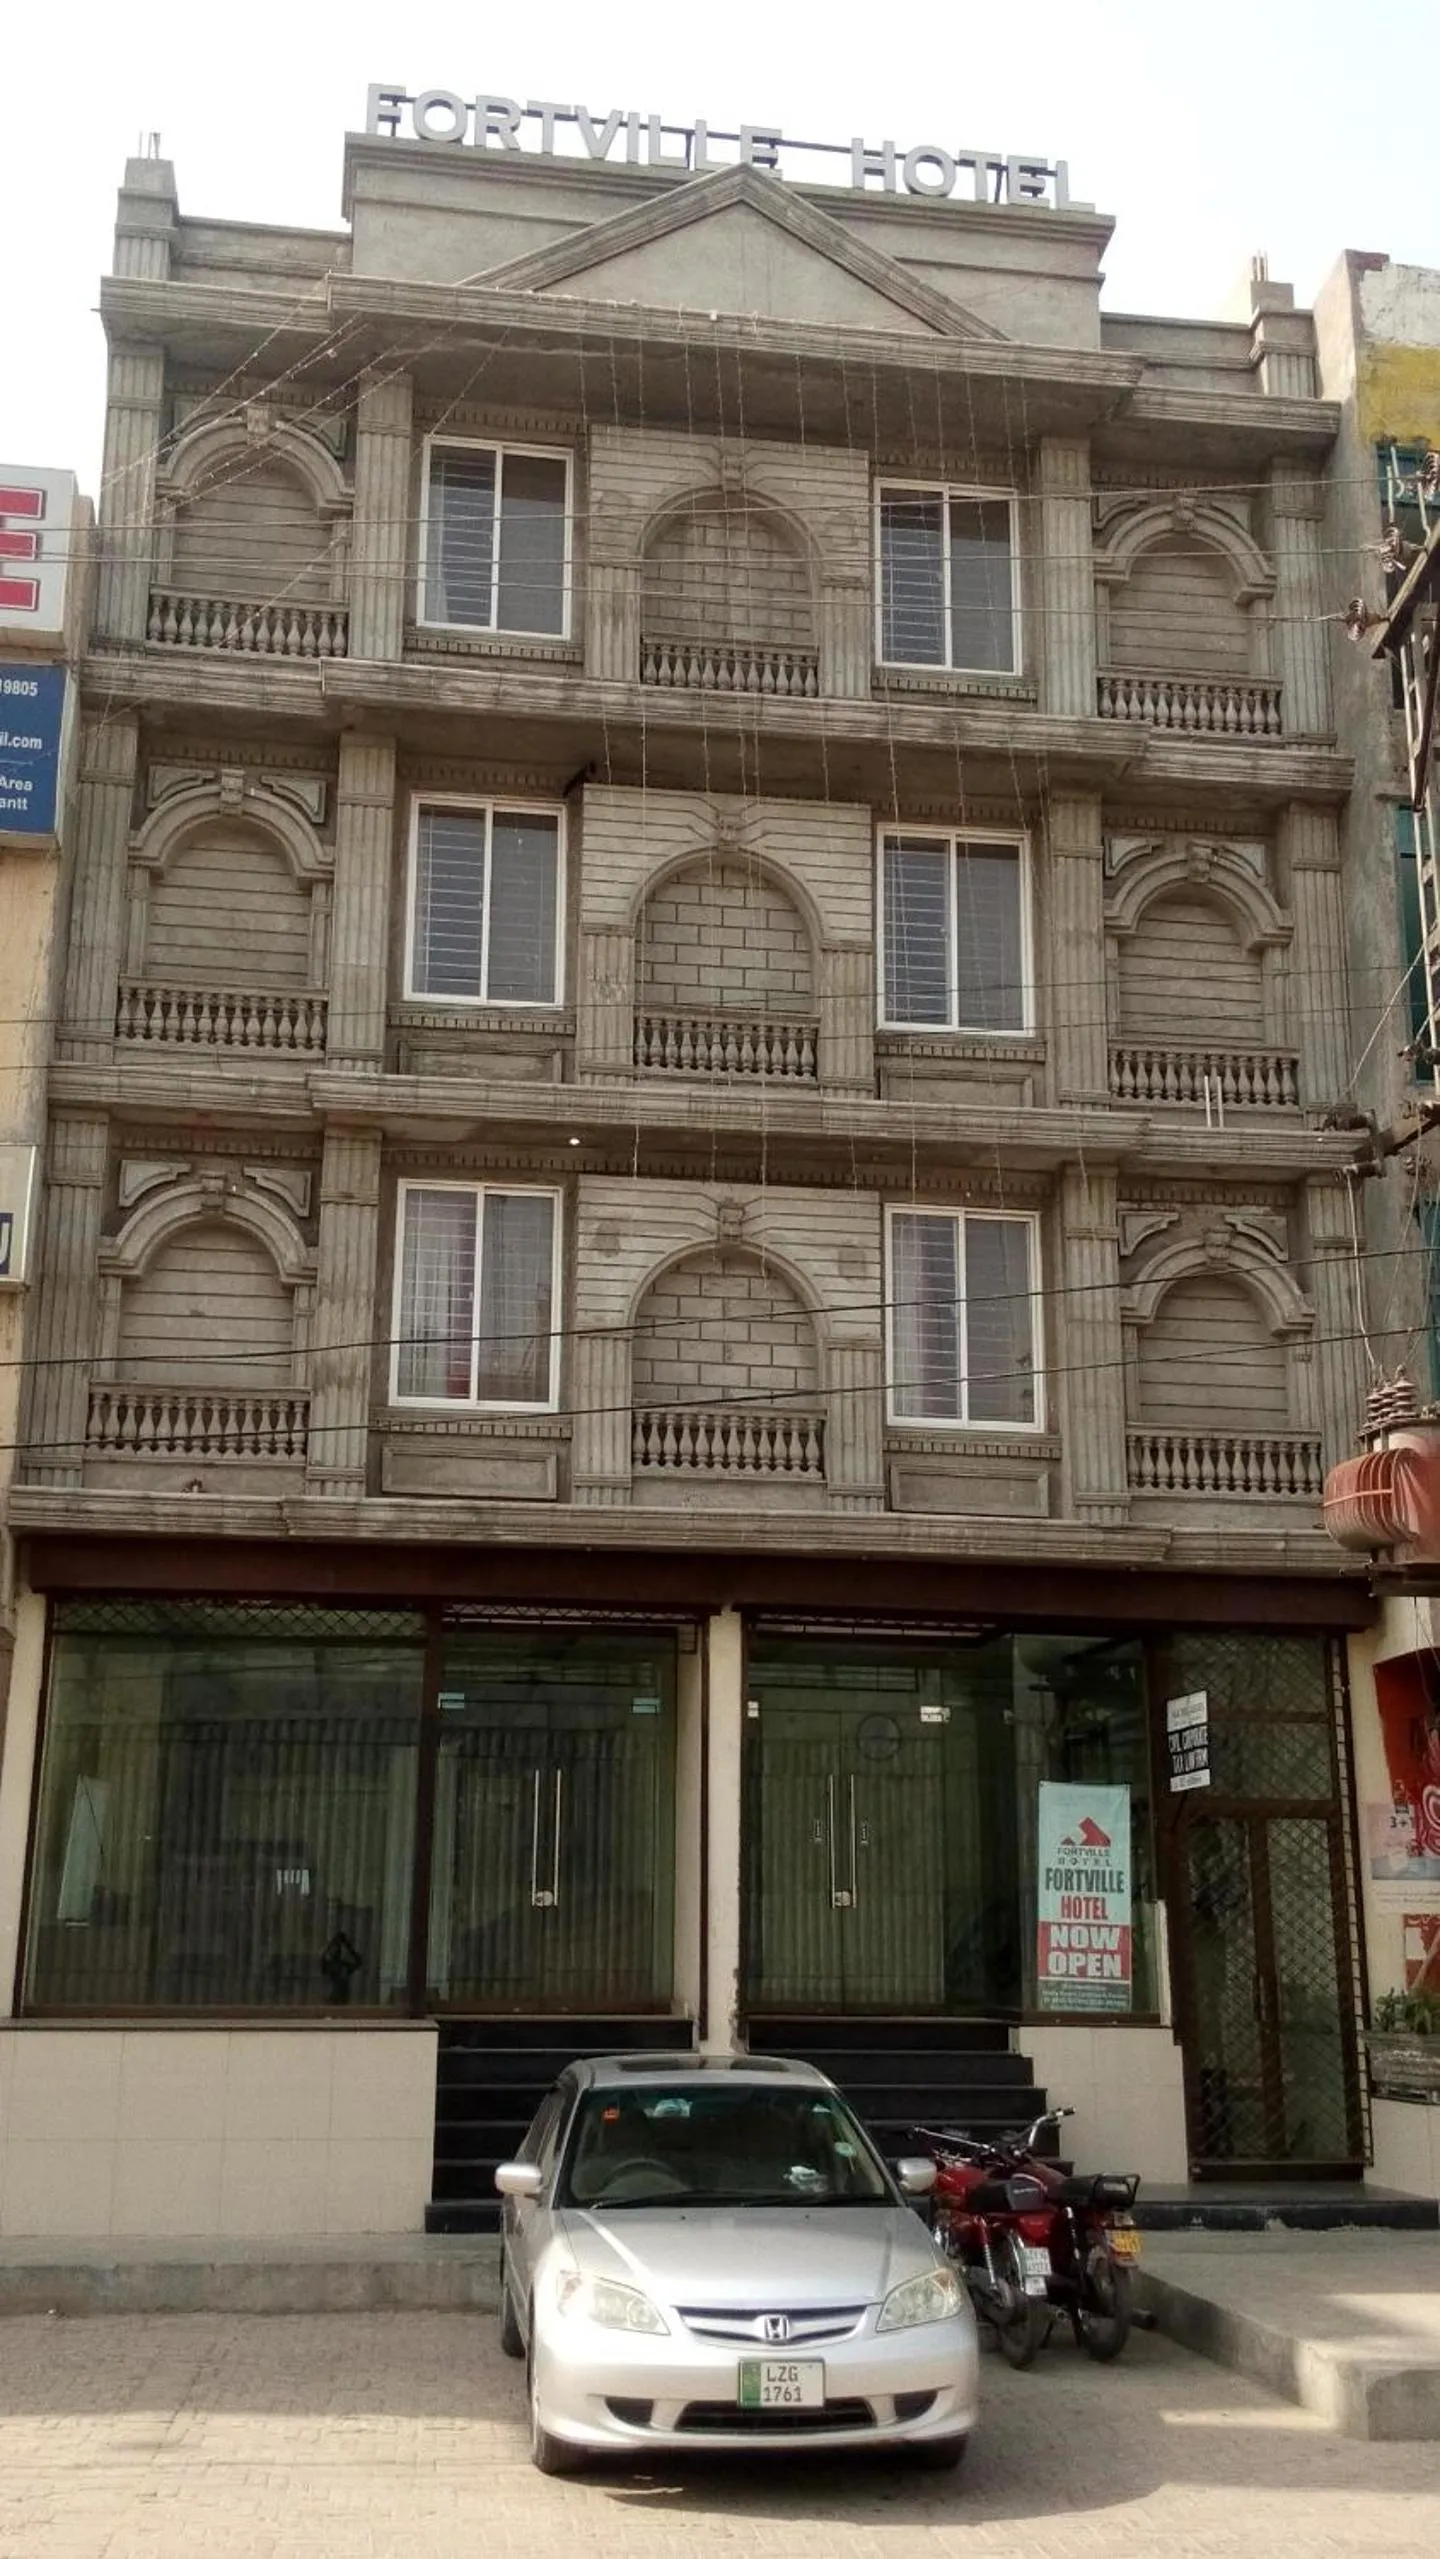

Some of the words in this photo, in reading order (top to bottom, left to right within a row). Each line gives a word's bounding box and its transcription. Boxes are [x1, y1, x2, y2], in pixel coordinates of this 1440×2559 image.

[366, 83, 783, 182] FORTVILLE
[851, 138, 1096, 213] HOTEL
[1045, 1867, 1125, 1894] FORTVILLE
[1061, 1895, 1108, 1920] HOTEL
[1050, 1924, 1120, 1950] NOW
[1048, 1951, 1122, 1978] OPEN
[767, 2366, 799, 2382] LZG
[764, 2386, 803, 2402] 1761
